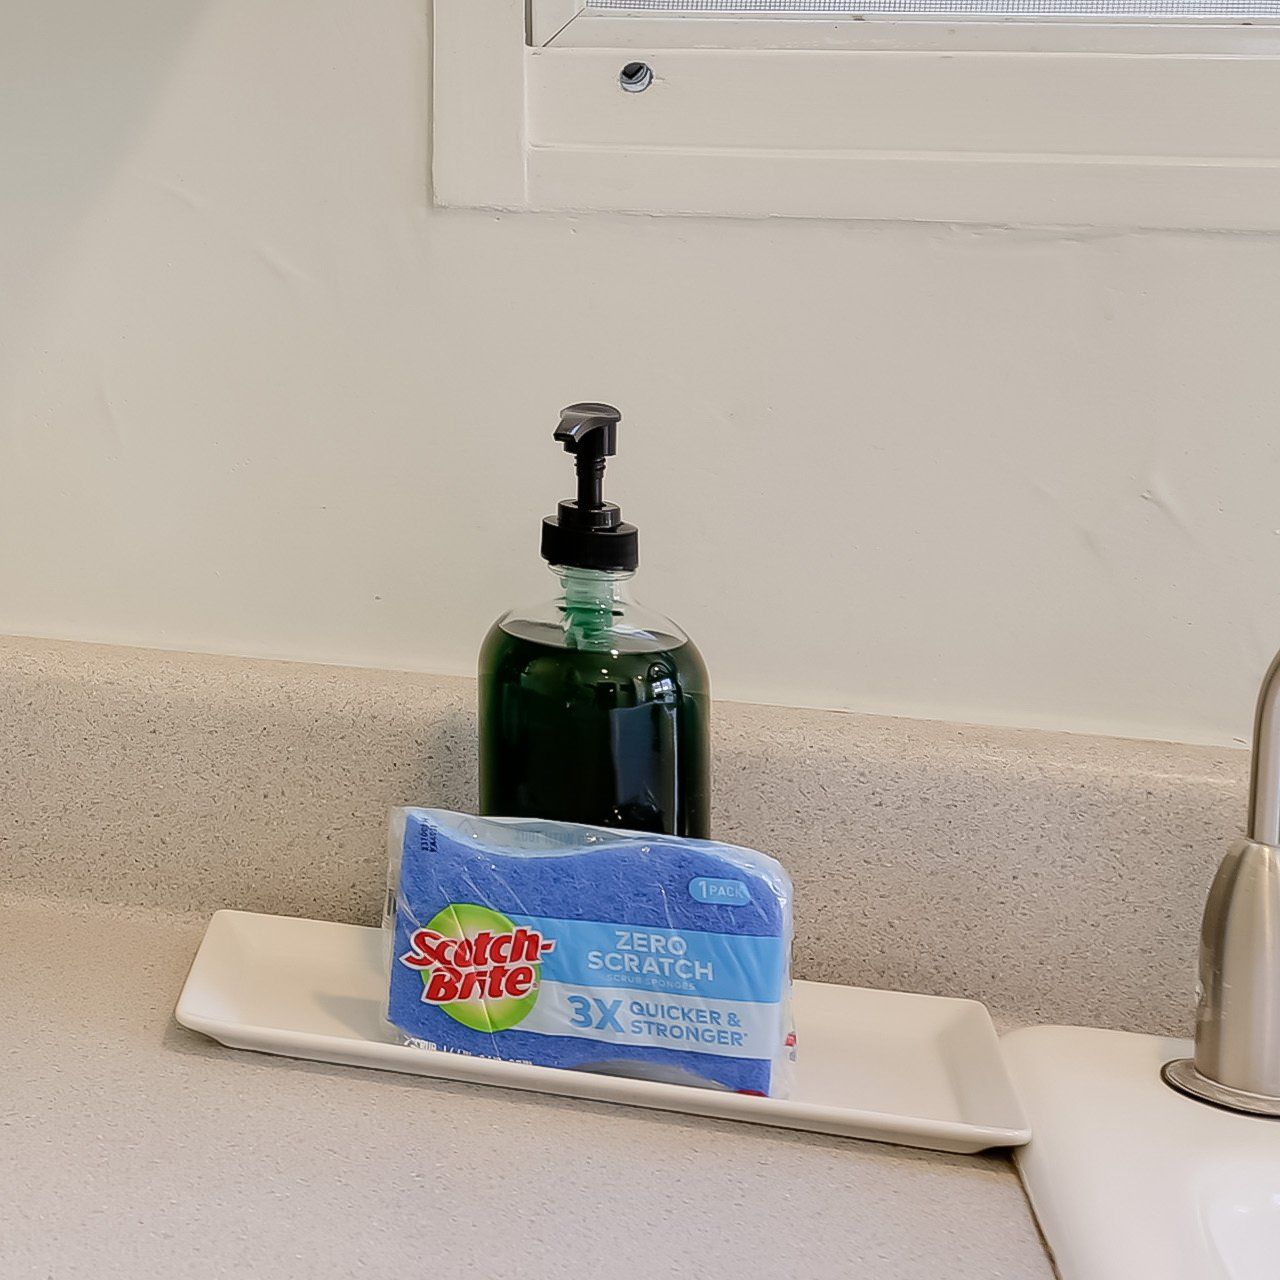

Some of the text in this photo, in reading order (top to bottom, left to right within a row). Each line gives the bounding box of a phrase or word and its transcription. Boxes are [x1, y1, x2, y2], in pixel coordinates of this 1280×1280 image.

[698, 880, 744, 899] 1 PACK
[403, 928, 554, 968] Scotch-
[615, 930, 687, 956] ZERO
[587, 951, 714, 982] SCRATCH
[425, 965, 534, 1002] Brite
[566, 994, 626, 1034] 3X
[629, 1000, 742, 1028] QUICKER &
